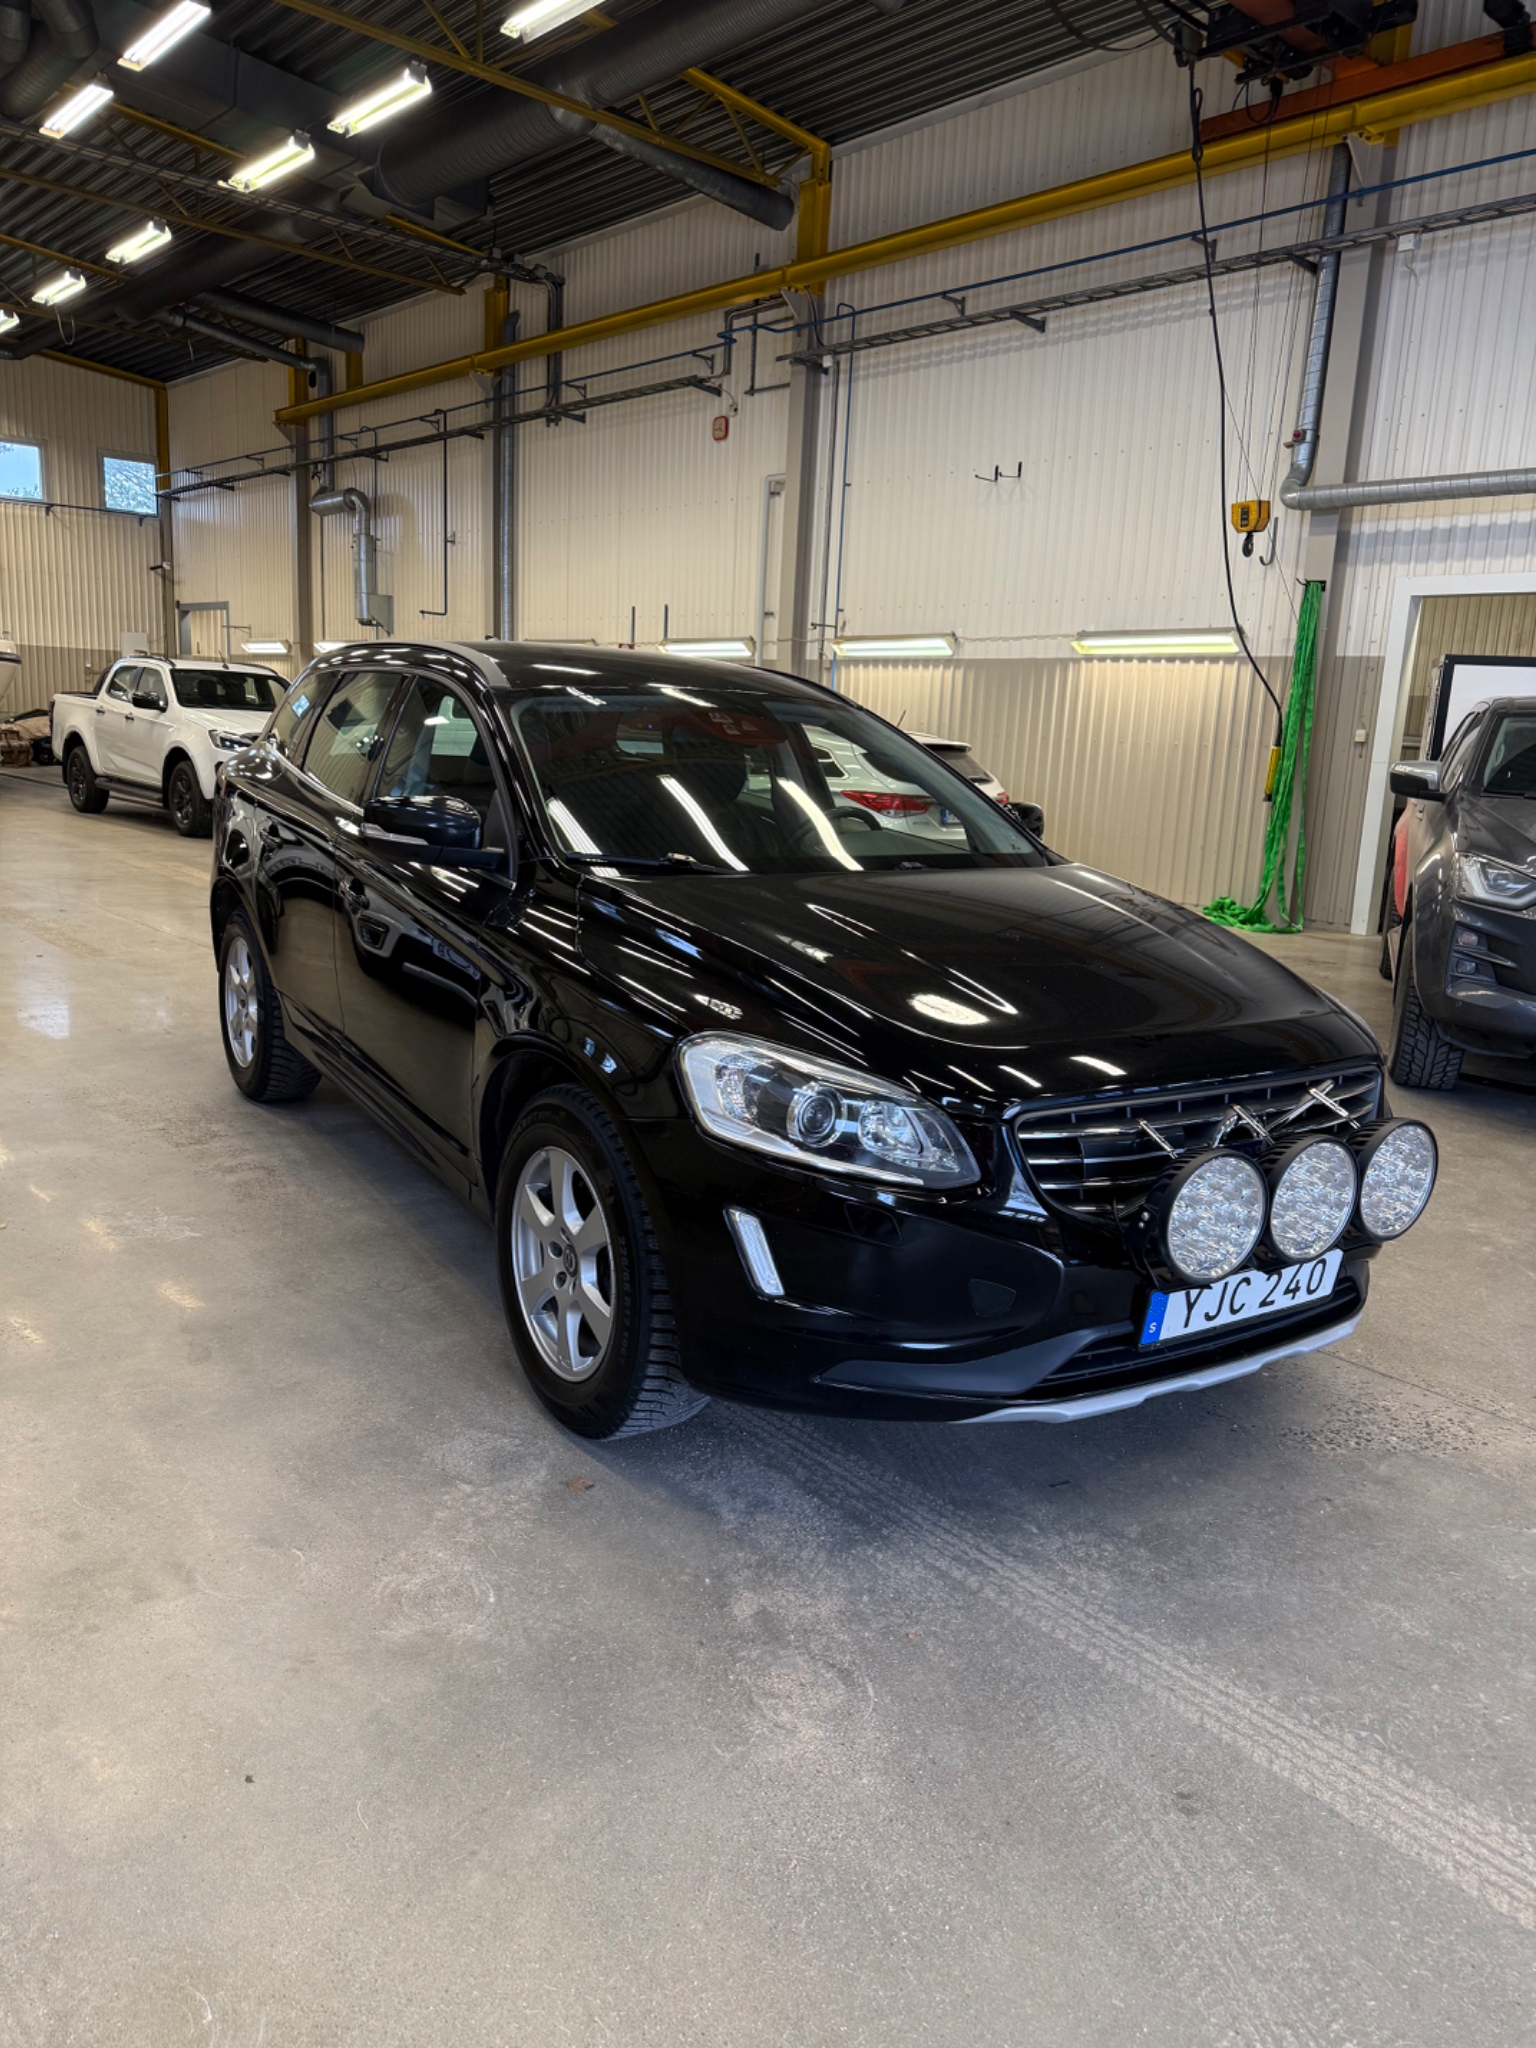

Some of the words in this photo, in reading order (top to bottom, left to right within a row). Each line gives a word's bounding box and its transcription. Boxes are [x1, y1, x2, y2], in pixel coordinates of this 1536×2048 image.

[1183, 1276, 1252, 1329] YJC
[1258, 1258, 1327, 1308] 240
[1148, 1322, 1157, 1333] S
